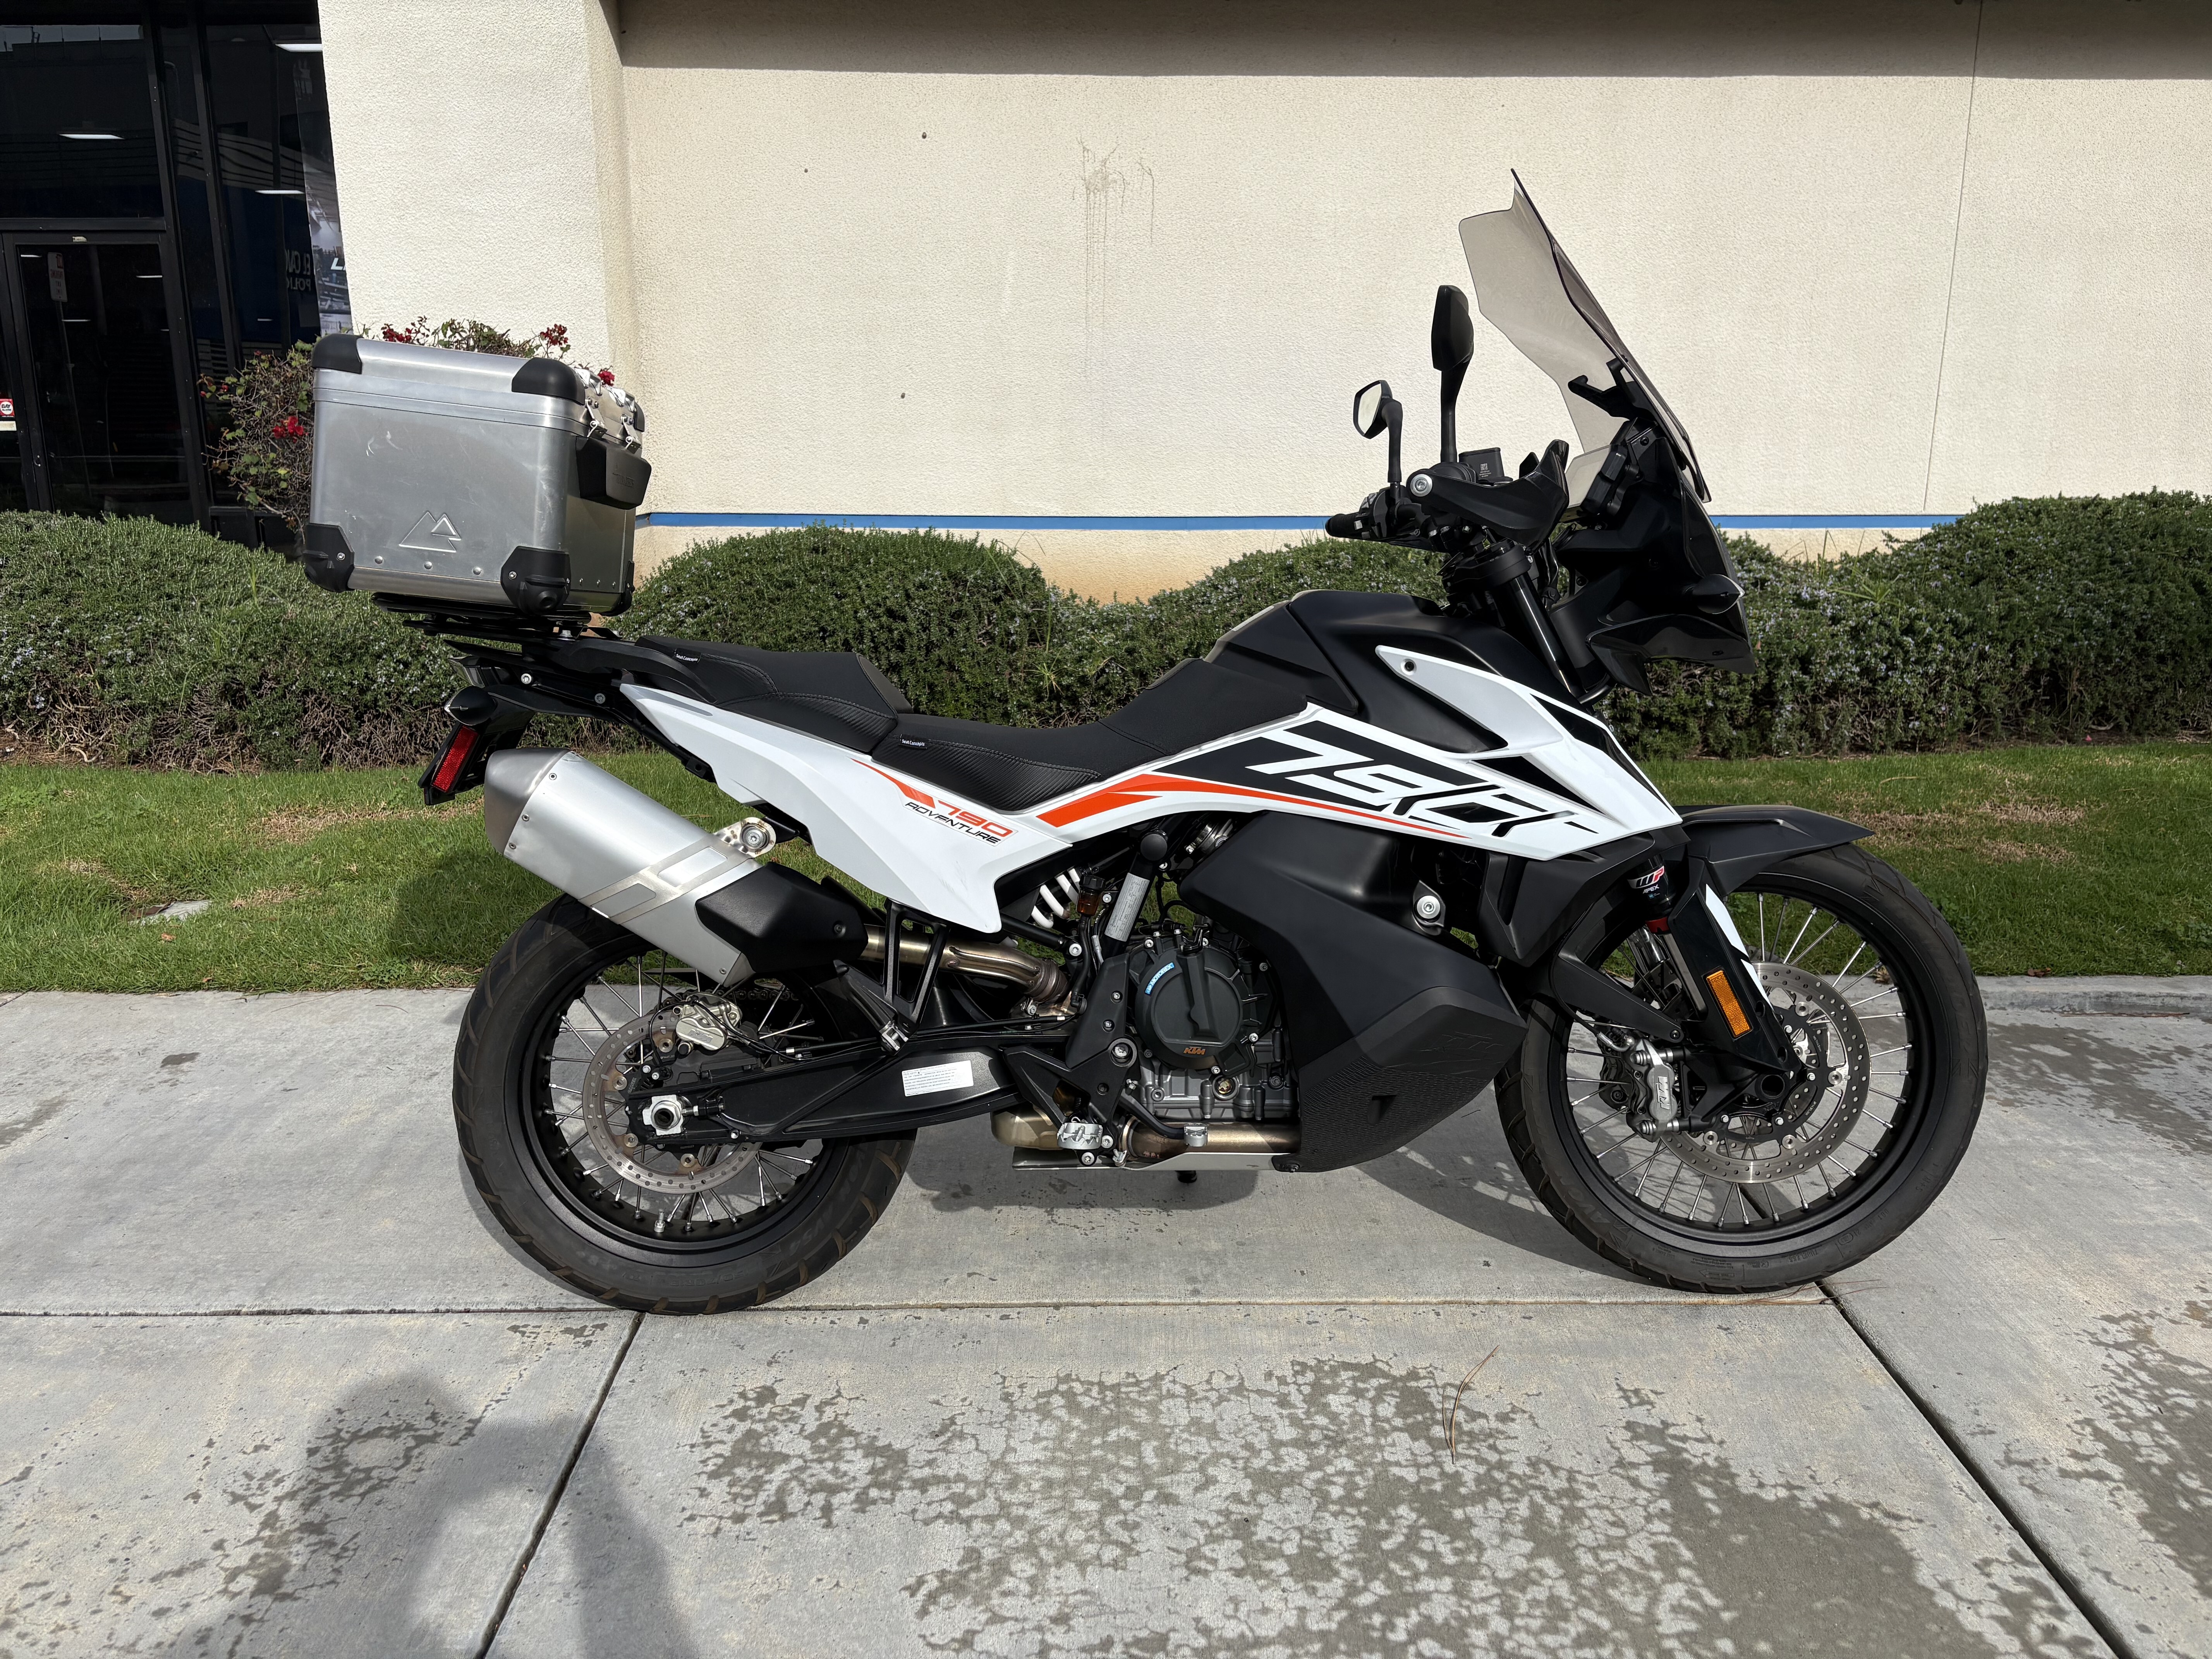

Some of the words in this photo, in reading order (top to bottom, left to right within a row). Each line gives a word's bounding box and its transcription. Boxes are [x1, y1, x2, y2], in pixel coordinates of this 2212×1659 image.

[905, 802, 1001, 845] ADVENTURE
[938, 800, 1013, 837] 790
[1636, 867, 1664, 888] WP
[1643, 884, 1660, 894] APEX
[1151, 964, 1172, 986] MOTOREX
[687, 1028, 713, 1043] KTM
[1183, 1046, 1206, 1055] KTM
[1656, 1076, 1669, 1110] KTM
